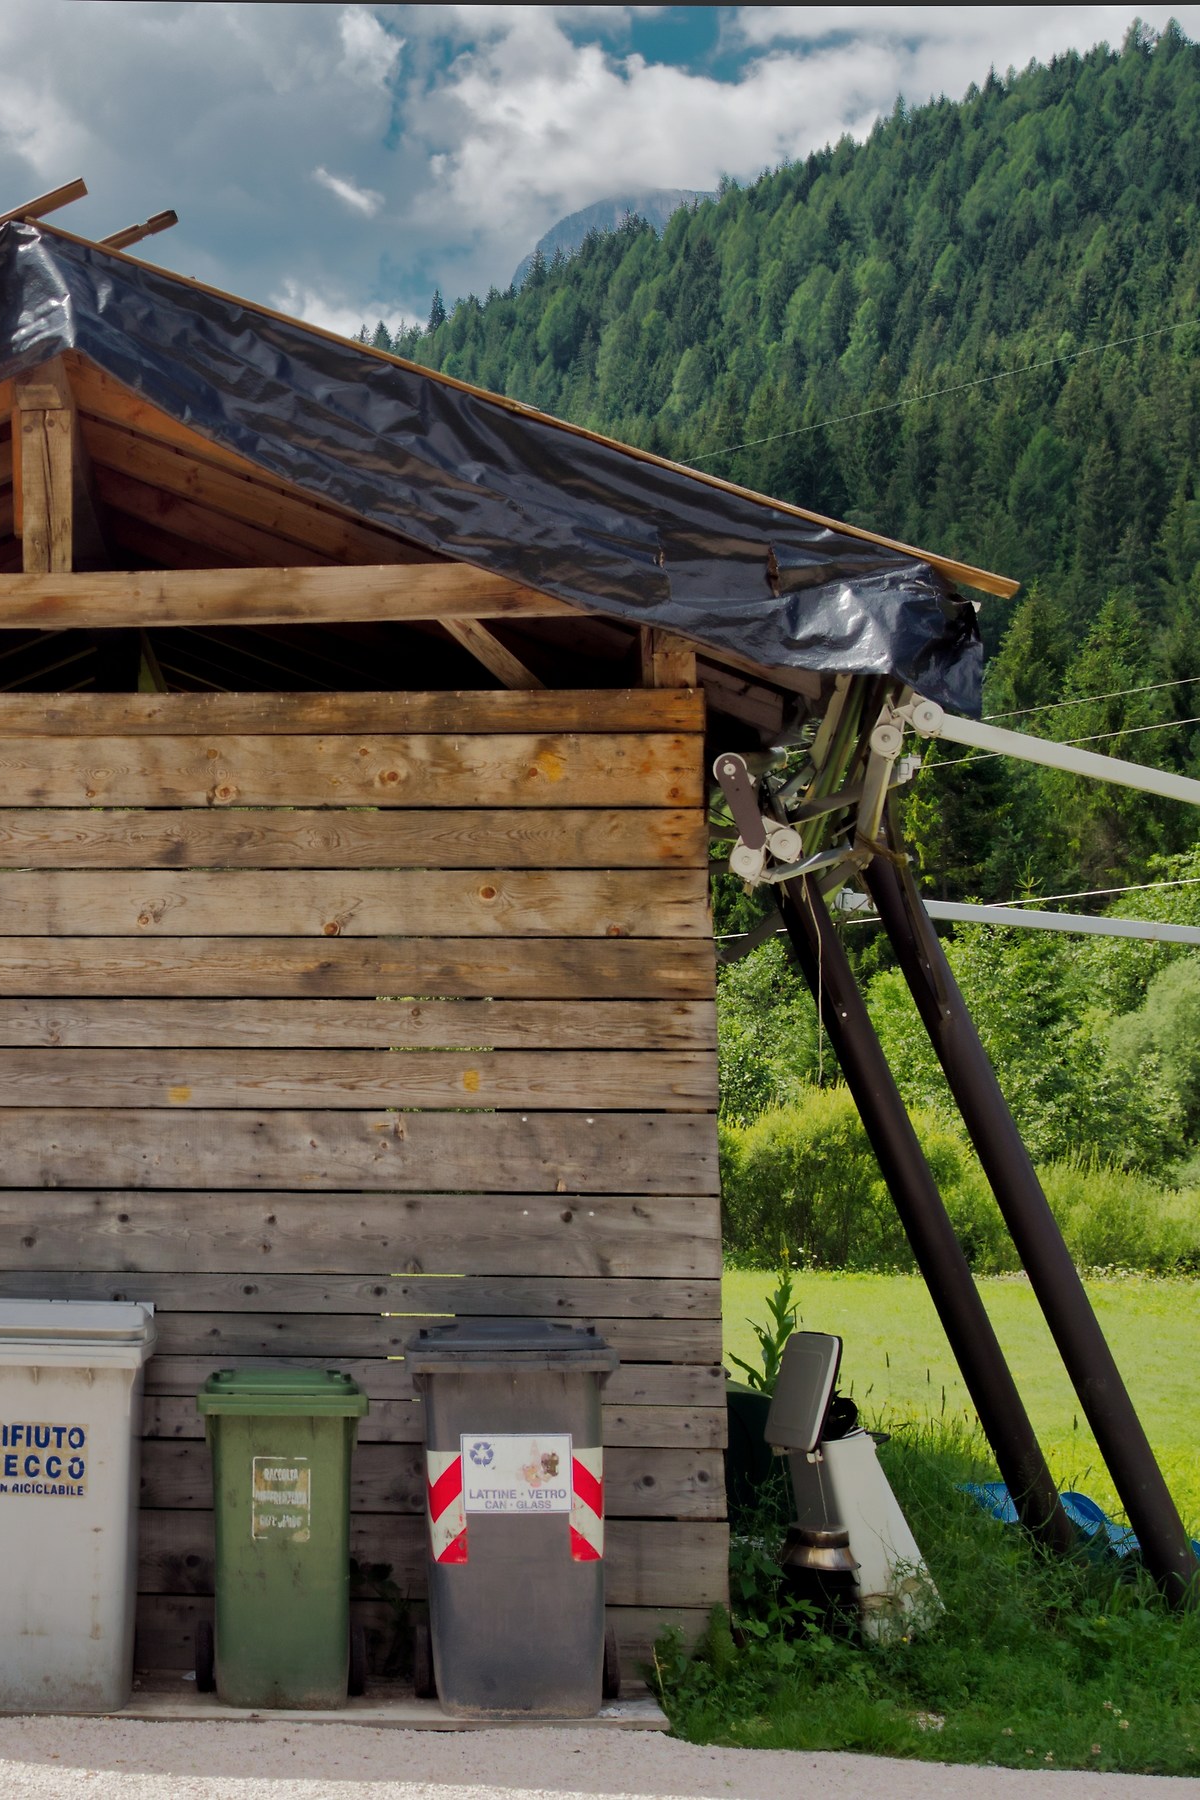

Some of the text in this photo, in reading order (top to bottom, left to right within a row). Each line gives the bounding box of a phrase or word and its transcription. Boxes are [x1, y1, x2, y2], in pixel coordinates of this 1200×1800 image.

[11, 1483, 84, 1496] RICICLABILE
[469, 1489, 567, 1499] LATTINE VETRO
[485, 1500, 552, 1509] CAN GLASS
